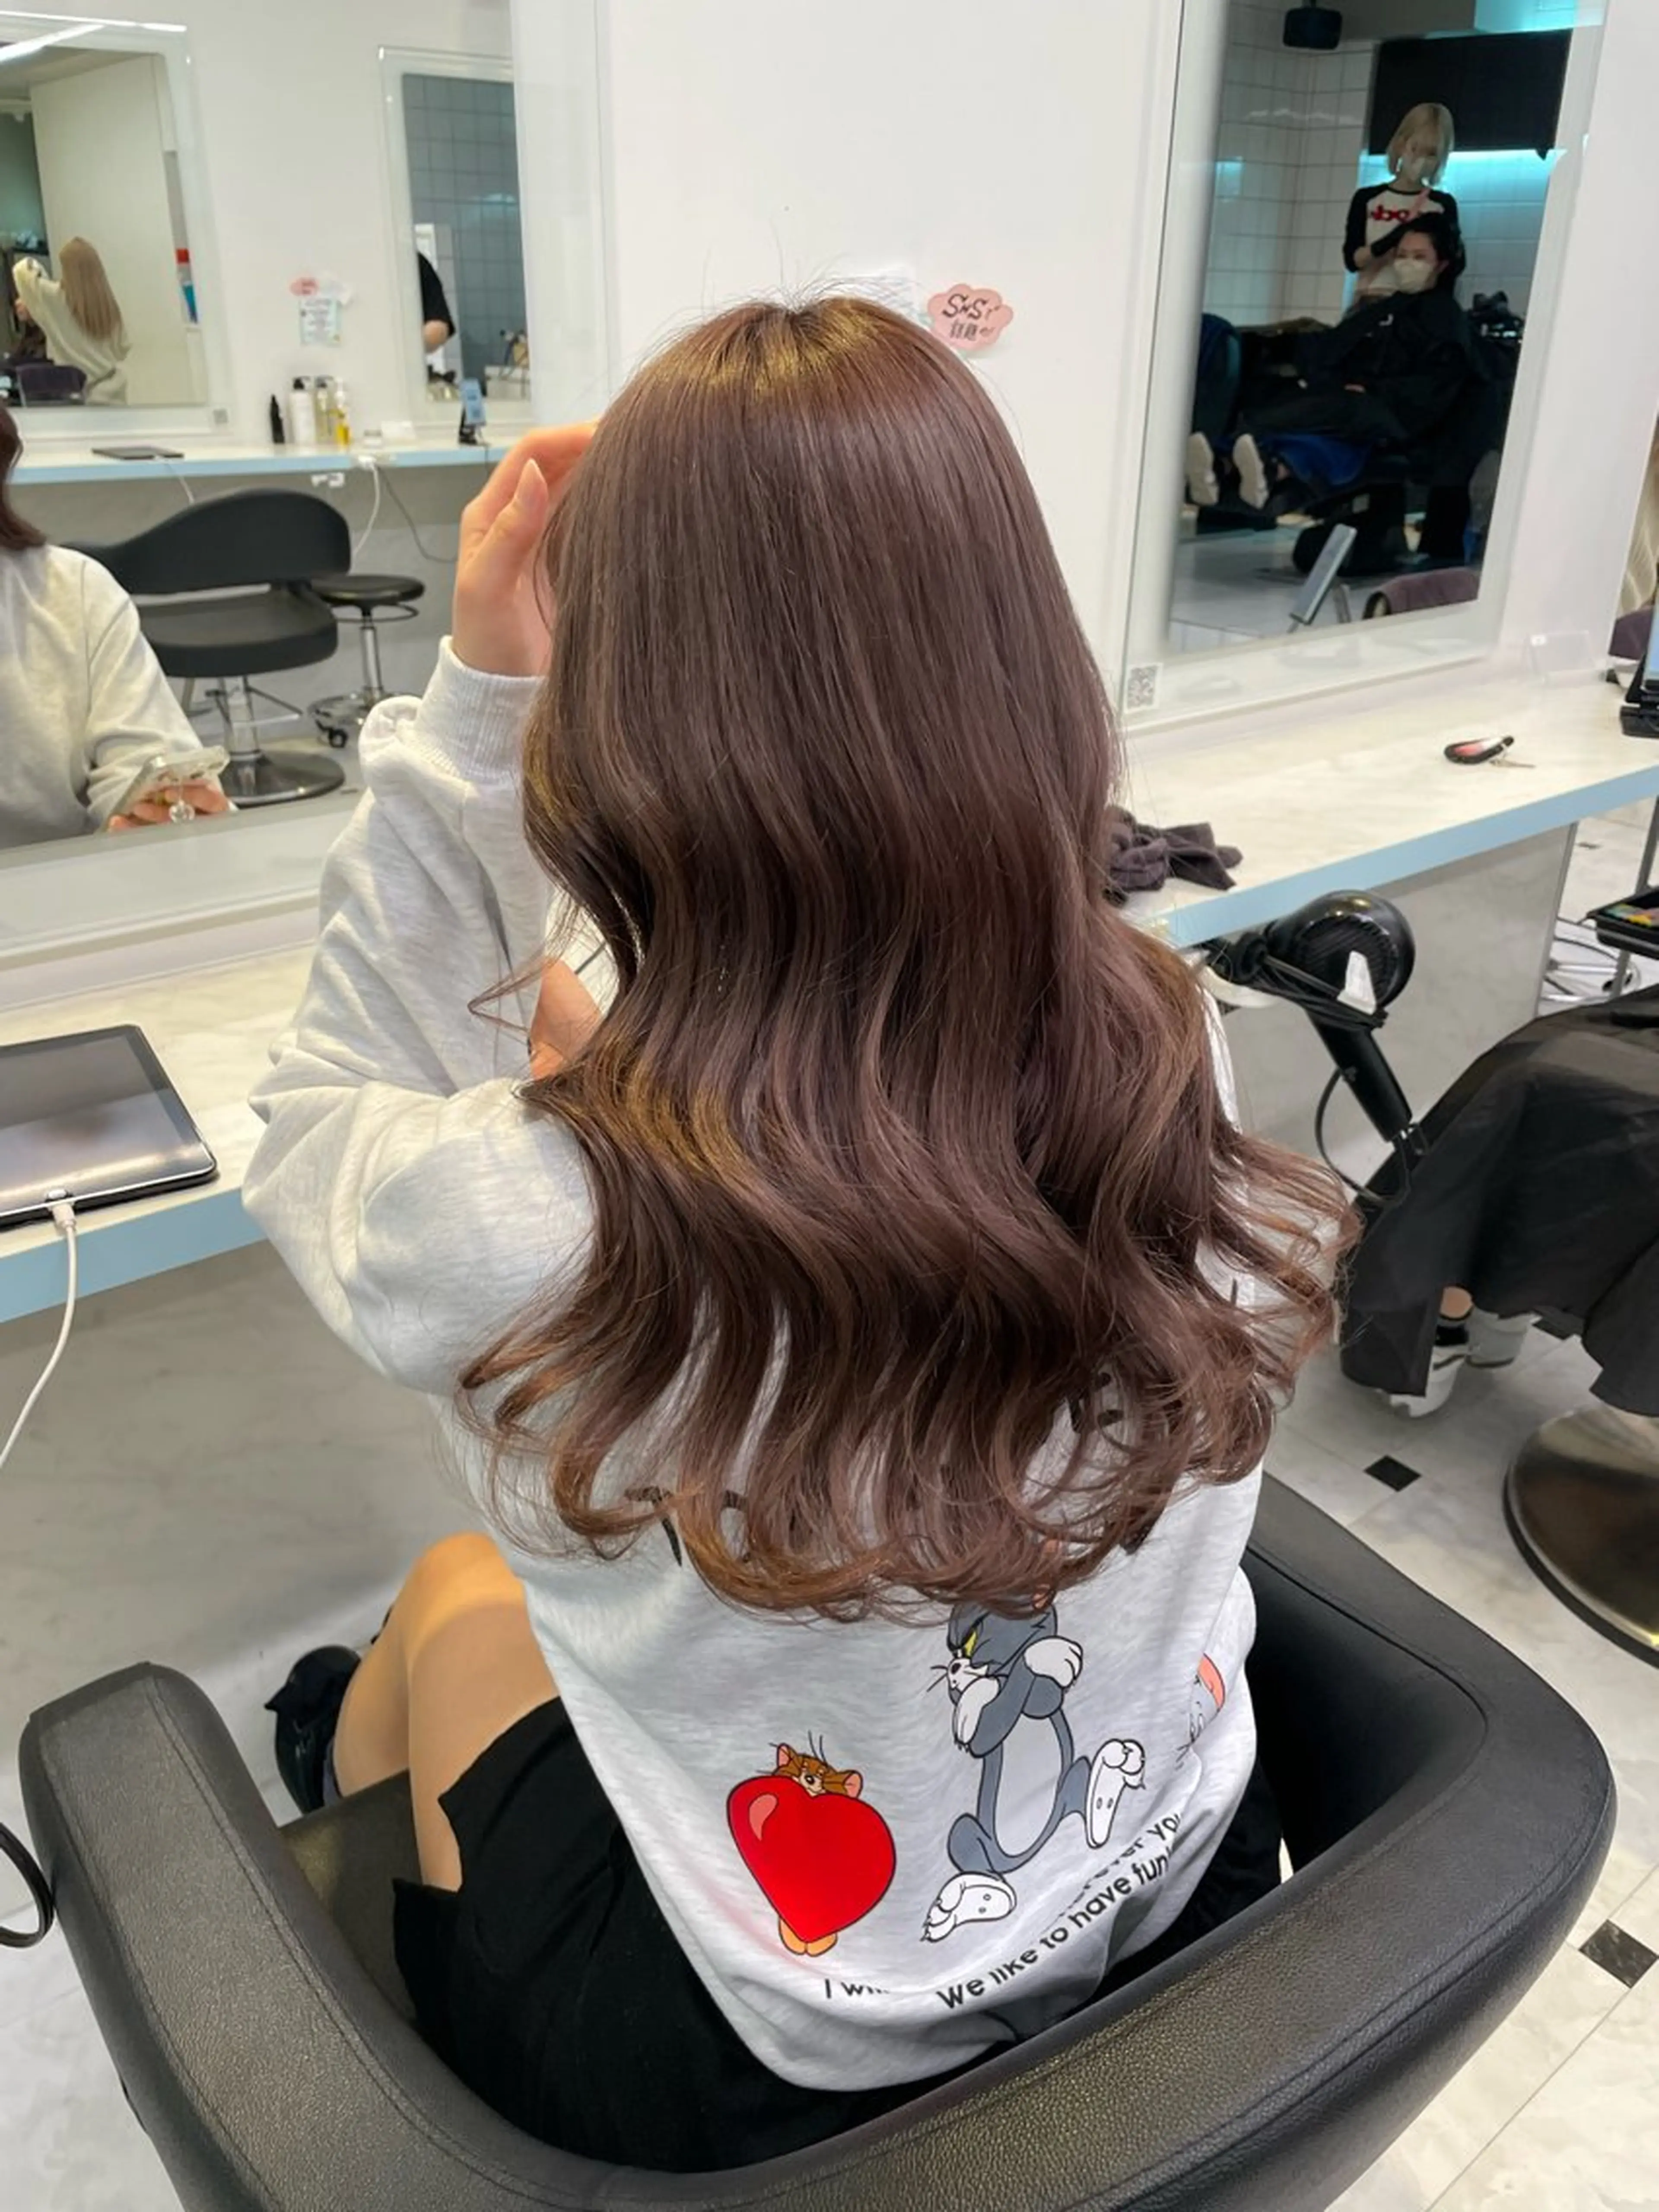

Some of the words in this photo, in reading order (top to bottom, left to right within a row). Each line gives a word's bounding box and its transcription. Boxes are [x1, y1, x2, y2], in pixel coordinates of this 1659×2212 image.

[936, 1979, 985, 2009] We
[988, 1949, 1038, 1984] like
[1039, 1927, 1068, 1949] to
[1068, 1877, 1132, 1928] have
[825, 1978, 832, 1999] I
